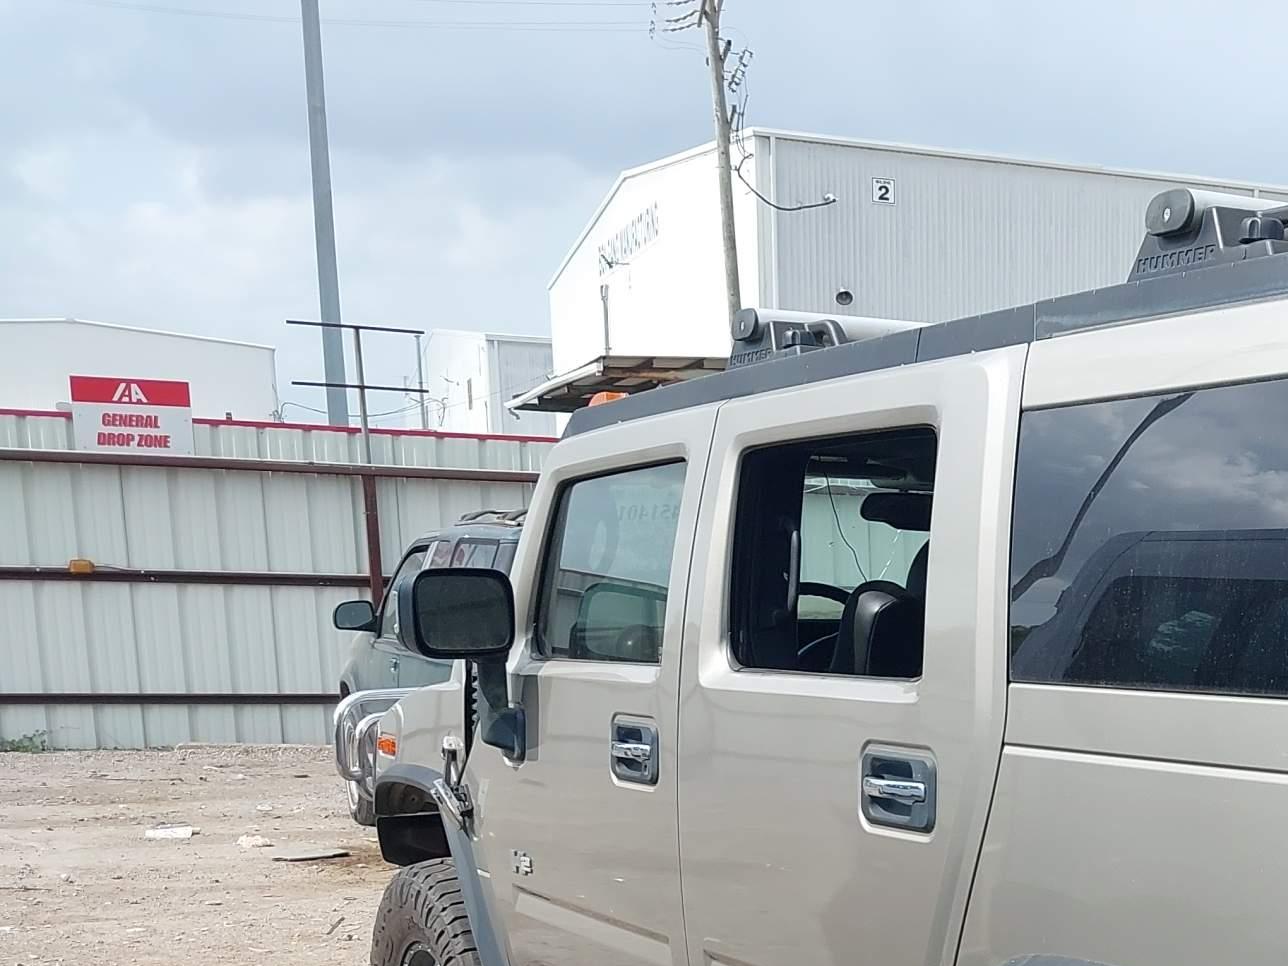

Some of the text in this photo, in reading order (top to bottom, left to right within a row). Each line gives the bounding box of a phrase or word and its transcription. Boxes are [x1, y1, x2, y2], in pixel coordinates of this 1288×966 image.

[878, 185, 890, 202] 2
[1136, 244, 1217, 274] HUMMER
[101, 412, 161, 429] GENERAL
[97, 432, 171, 448] DROP ZONE
